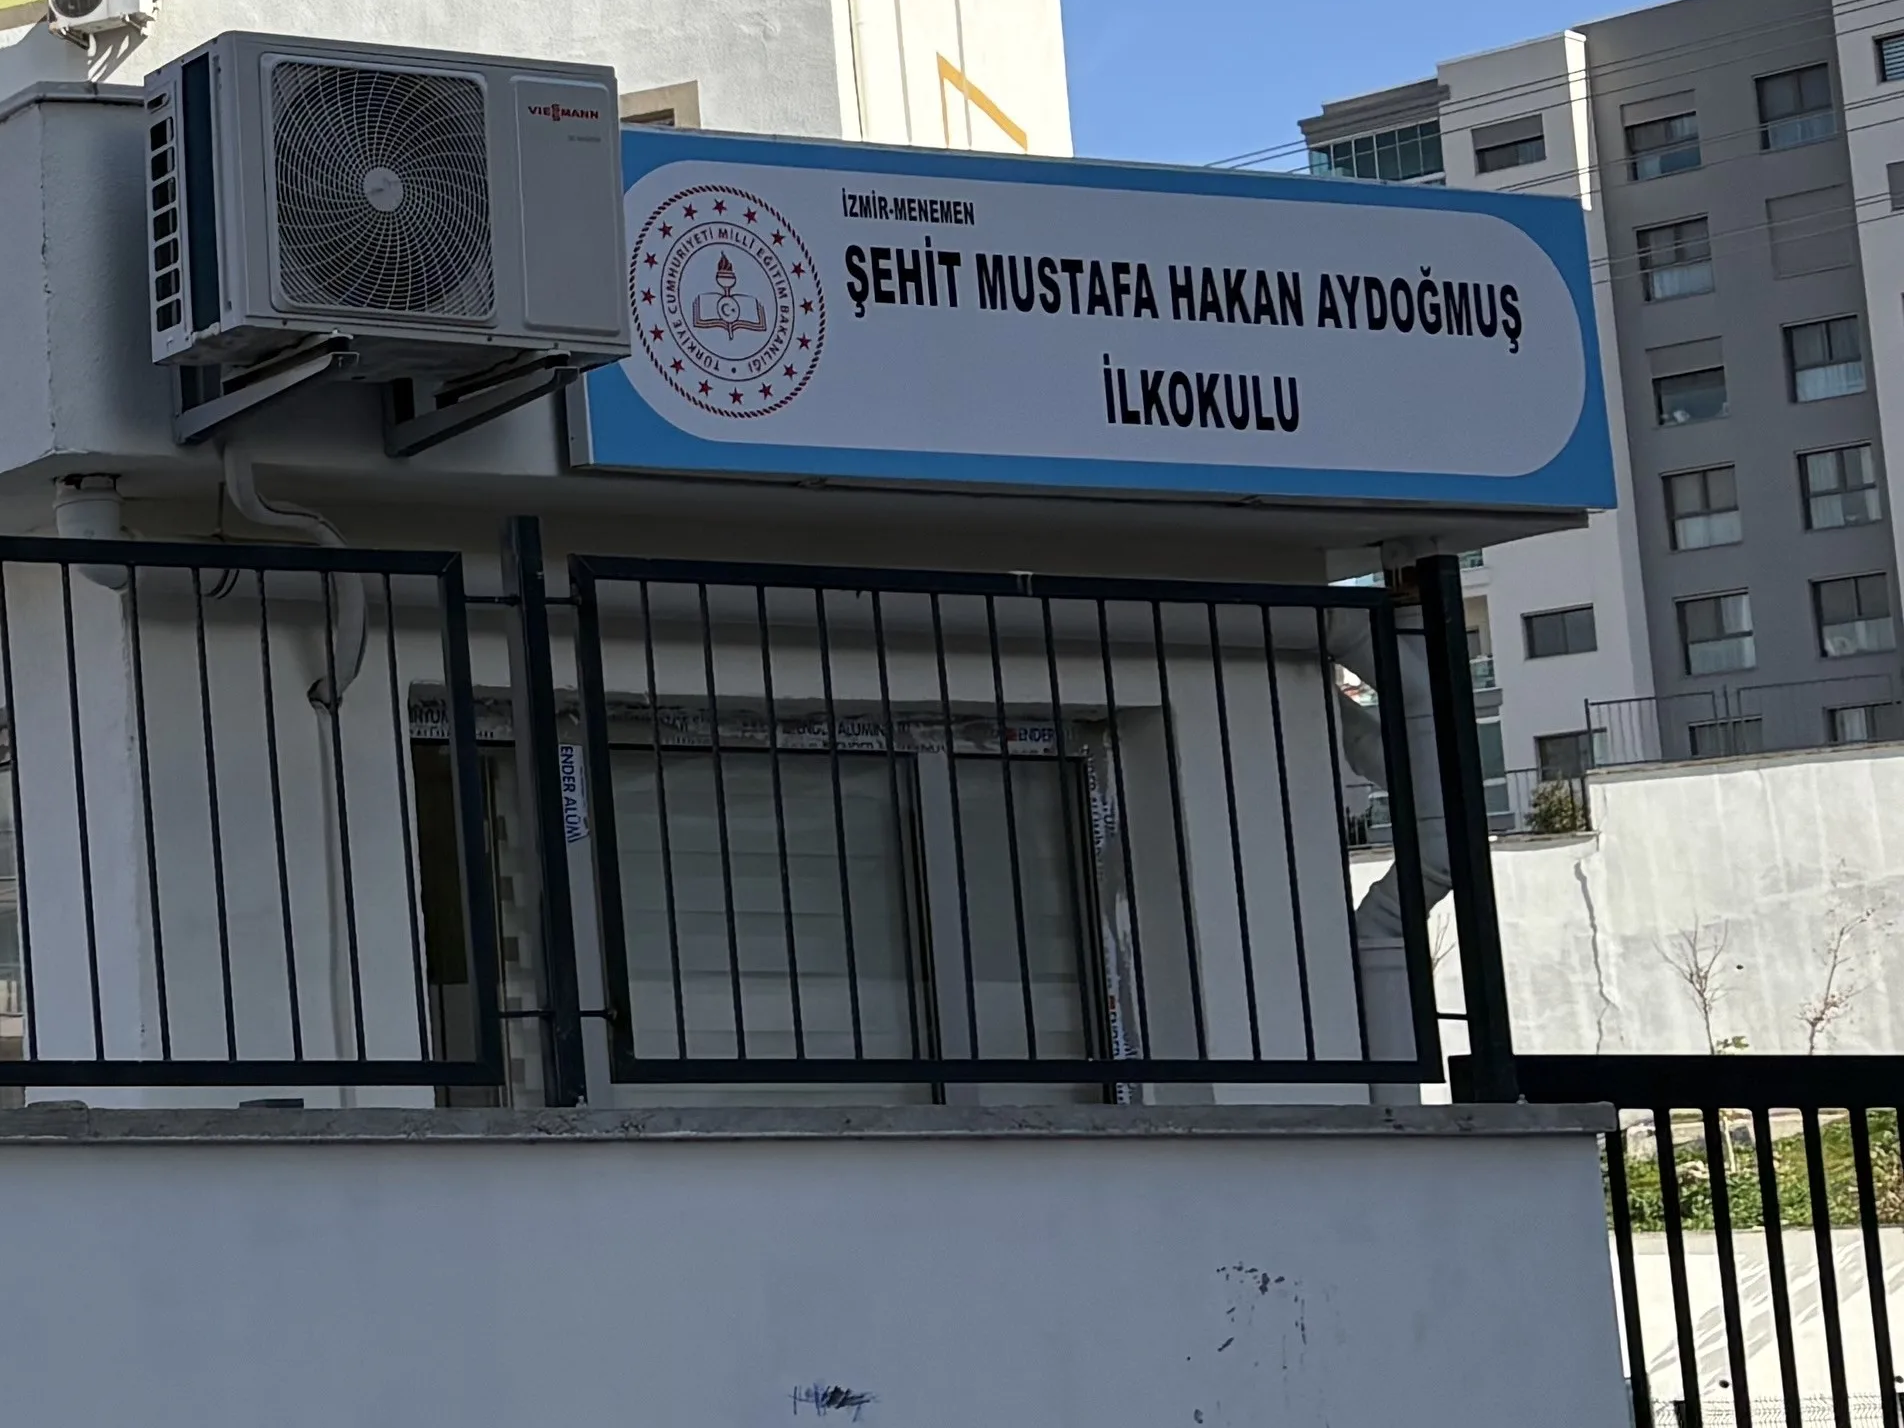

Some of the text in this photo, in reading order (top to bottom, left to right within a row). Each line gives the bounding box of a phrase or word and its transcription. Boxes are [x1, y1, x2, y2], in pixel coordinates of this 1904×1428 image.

[841, 188, 975, 226] İZMİR-MENEMEN
[845, 235, 1523, 355] ŞEHİT MUSTAFA HAKAN AYDOĞMUŞ
[1102, 352, 1301, 434] İLKOKULU
